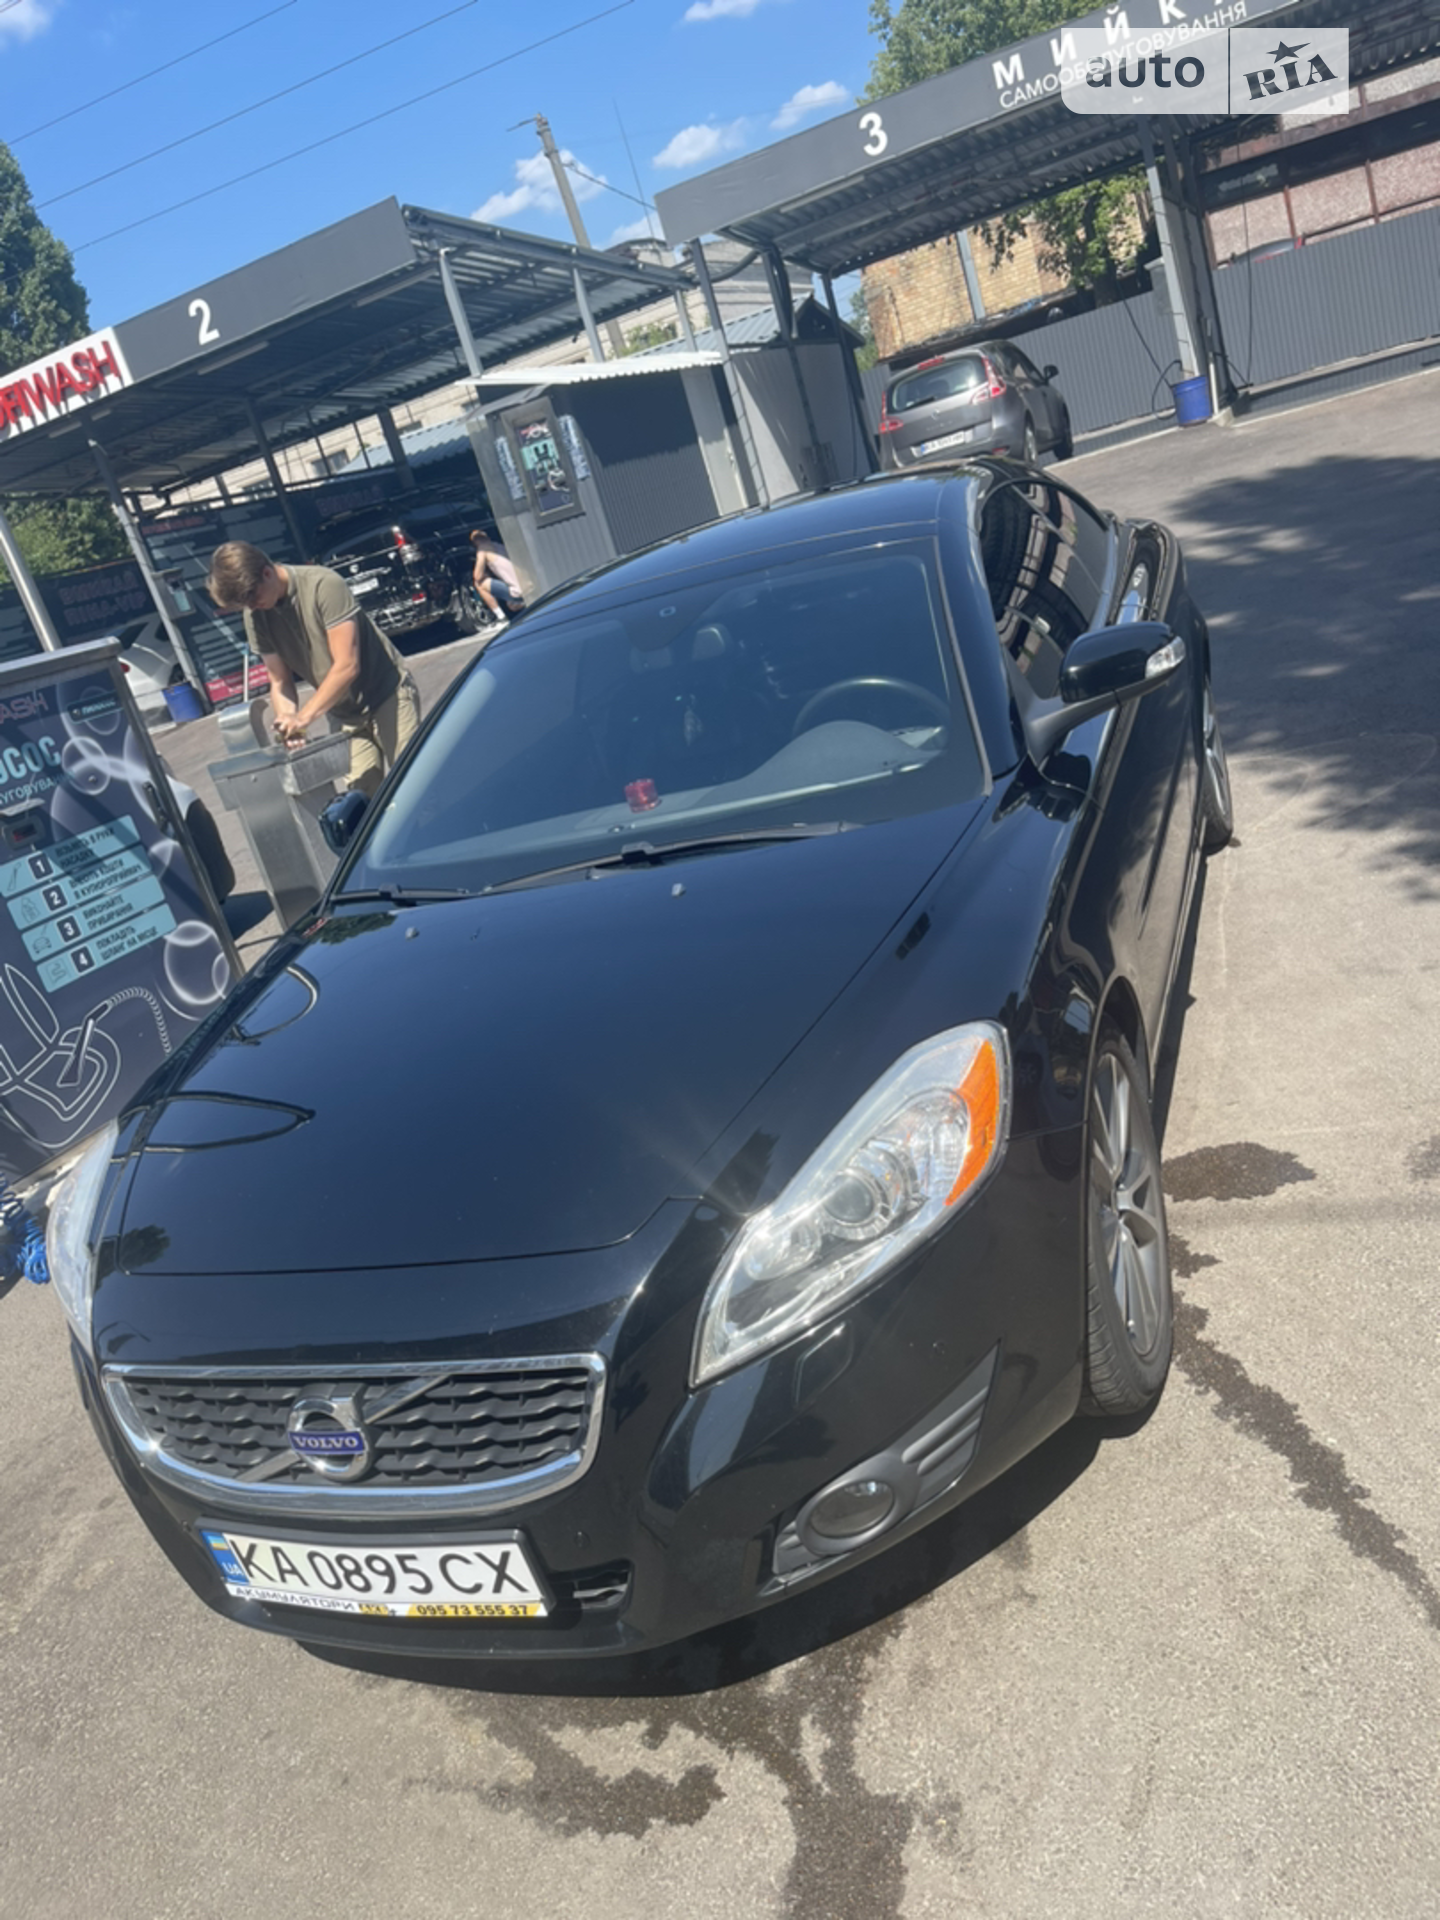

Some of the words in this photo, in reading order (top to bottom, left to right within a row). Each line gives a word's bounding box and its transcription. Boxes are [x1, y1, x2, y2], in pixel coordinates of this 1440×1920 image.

[991, 0, 1221, 90] МИЙК
[859, 111, 888, 156] 3
[188, 298, 220, 345] 2
[35, 859, 46, 873] 1
[49, 890, 61, 905] 2
[64, 921, 75, 936] 3
[79, 952, 89, 967] 4
[292, 1435, 359, 1449] VOLVO
[222, 1562, 245, 1577] UA
[229, 1539, 310, 1587] KA
[306, 1550, 434, 1595] 0895
[438, 1550, 530, 1595] CX
[235, 1587, 356, 1612] АКУМУЛЯТОРИ
[416, 1604, 447, 1616] 095
[449, 1604, 472, 1616] 73
[474, 1604, 506, 1616] 555
[508, 1604, 528, 1616] 37
